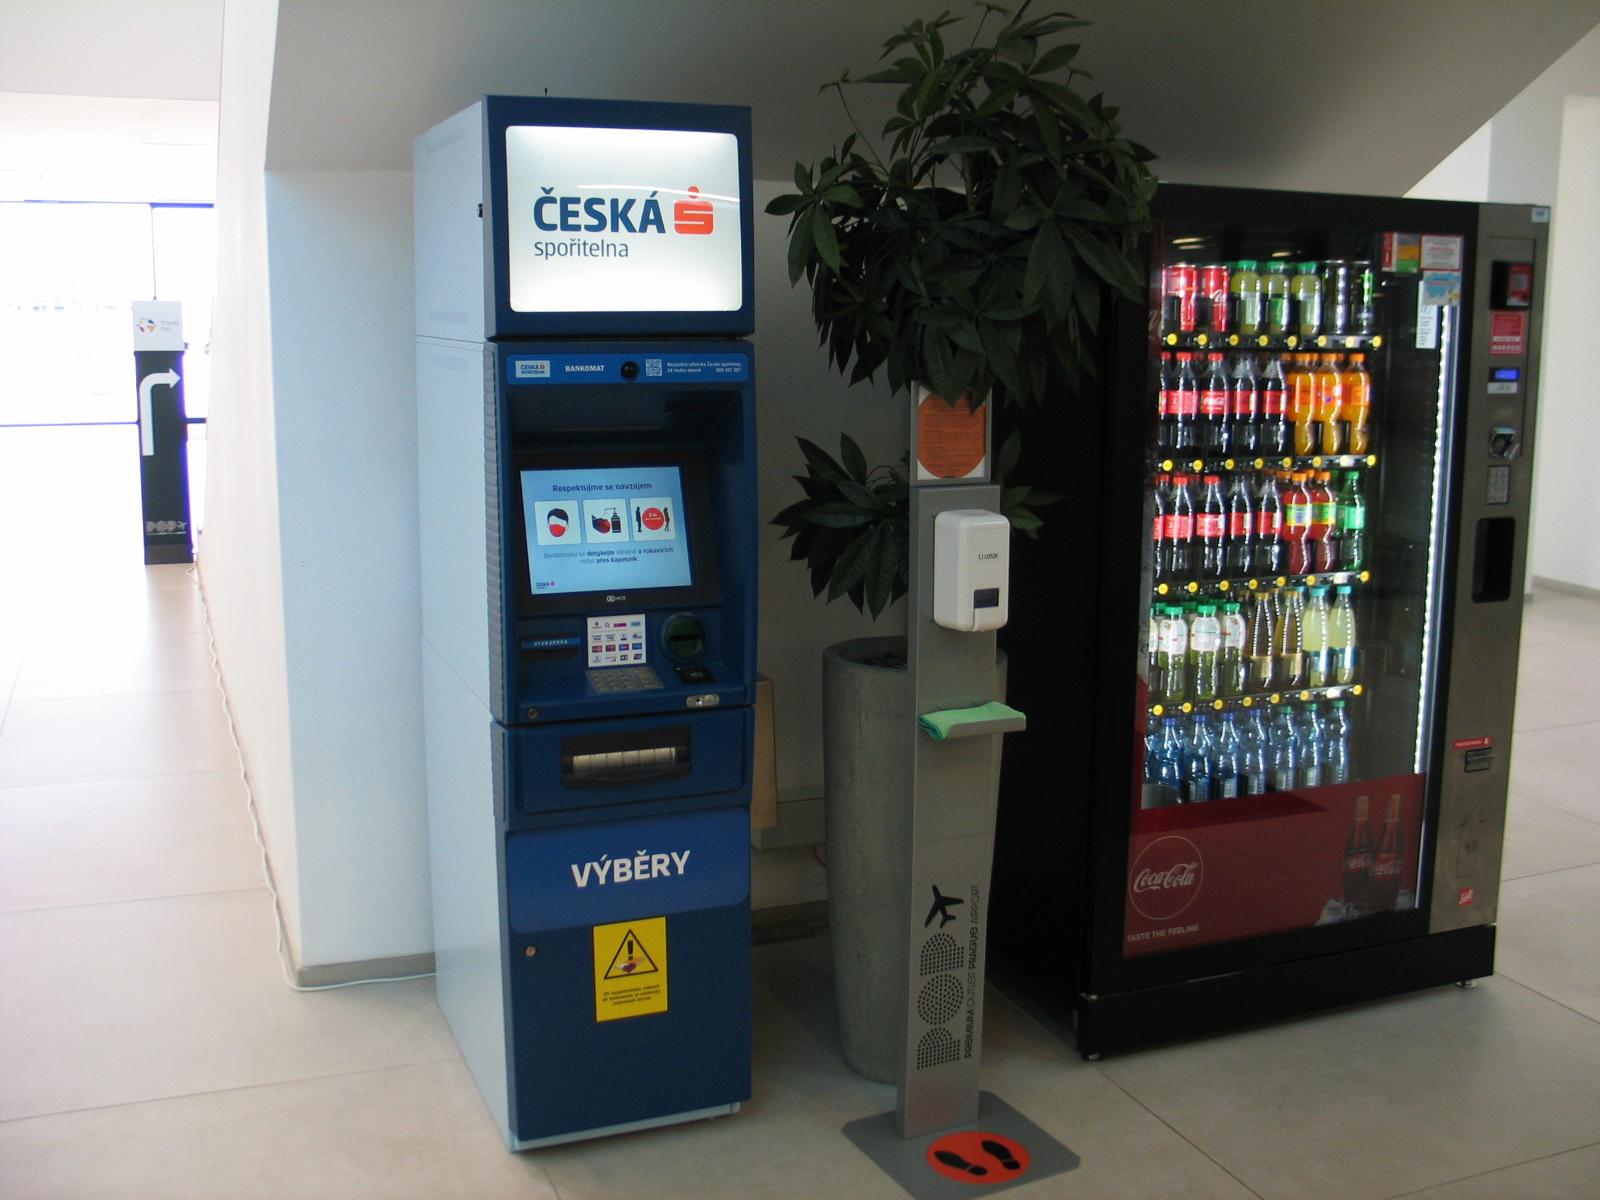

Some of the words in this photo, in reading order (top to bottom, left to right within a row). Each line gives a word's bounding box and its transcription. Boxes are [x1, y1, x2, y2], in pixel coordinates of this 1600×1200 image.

[534, 186, 666, 234] ČESKÁ
[534, 238, 629, 260] spořitelna
[552, 484, 603, 493] Respektujme
[571, 850, 691, 888] VÝBĚRY
[1133, 862, 1199, 893] Coca-Cola
[1127, 932, 1151, 942] TASTE
[1152, 929, 1167, 939] THE
[1168, 924, 1200, 936] FEELING
